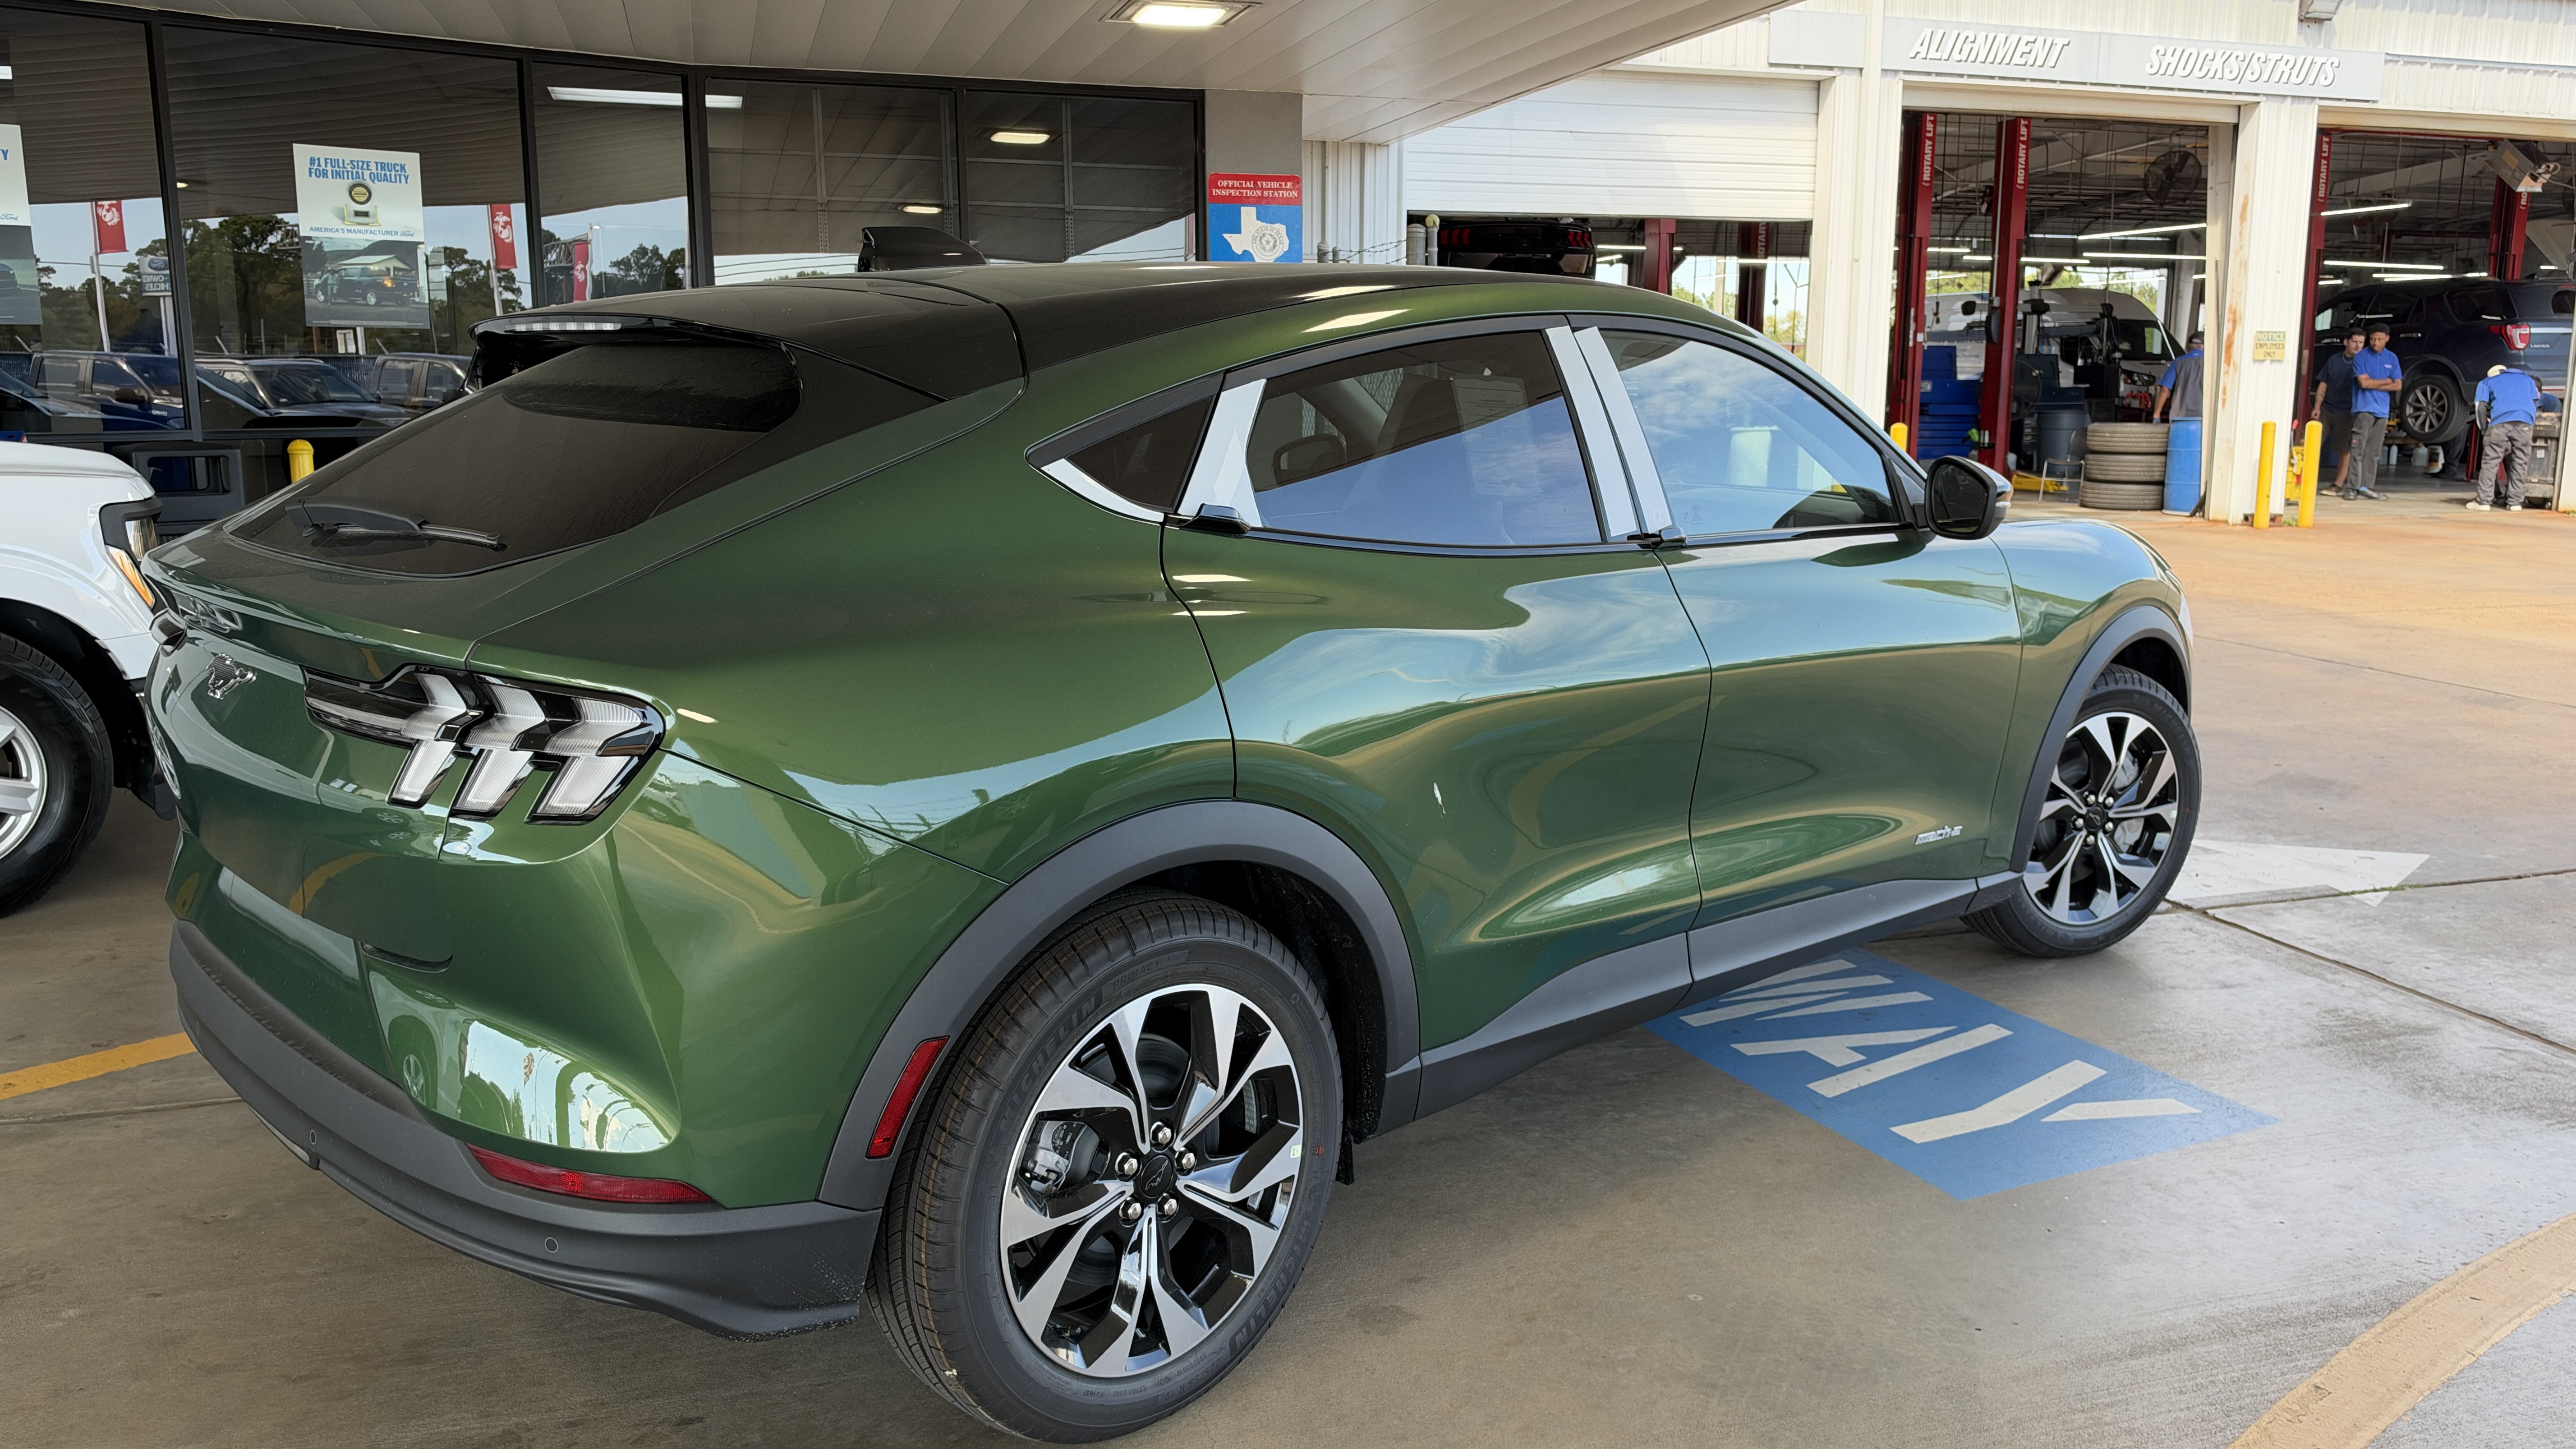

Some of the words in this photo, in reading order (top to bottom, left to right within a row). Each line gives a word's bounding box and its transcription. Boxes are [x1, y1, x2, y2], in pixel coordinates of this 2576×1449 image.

[1909, 27, 2071, 69] ALIGNMENT
[2144, 44, 2340, 87] SHOCKS/STRUTS
[1925, 114, 1934, 137] LIFT
[1923, 139, 1933, 181] ROTARY
[2321, 136, 2329, 157] LIFT
[308, 167, 329, 179] FOR
[331, 169, 366, 181] INITIAL
[369, 171, 409, 184] QUALITY
[309, 156, 322, 168] #1
[324, 157, 372, 171] FULL-SIZE
[373, 161, 407, 174] TRUCK
[2017, 143, 2027, 184] ROTARY
[2318, 159, 2328, 198] ROTARY
[1212, 189, 1262, 197] INSPECTION
[1263, 190, 1298, 198] STATION
[1217, 180, 1255, 188] OFFICIAL
[1257, 181, 1293, 189] VEHICLE
[346, 228, 399, 236] MANUFACTURER
[2256, 331, 2286, 341] NOTICE
[1000, 992, 1100, 1133] MICHELIN
[1113, 959, 1162, 989] PRIMACY
[1679, 958, 2202, 1145] WAY
[1235, 1219, 1312, 1350] MICHELIN
